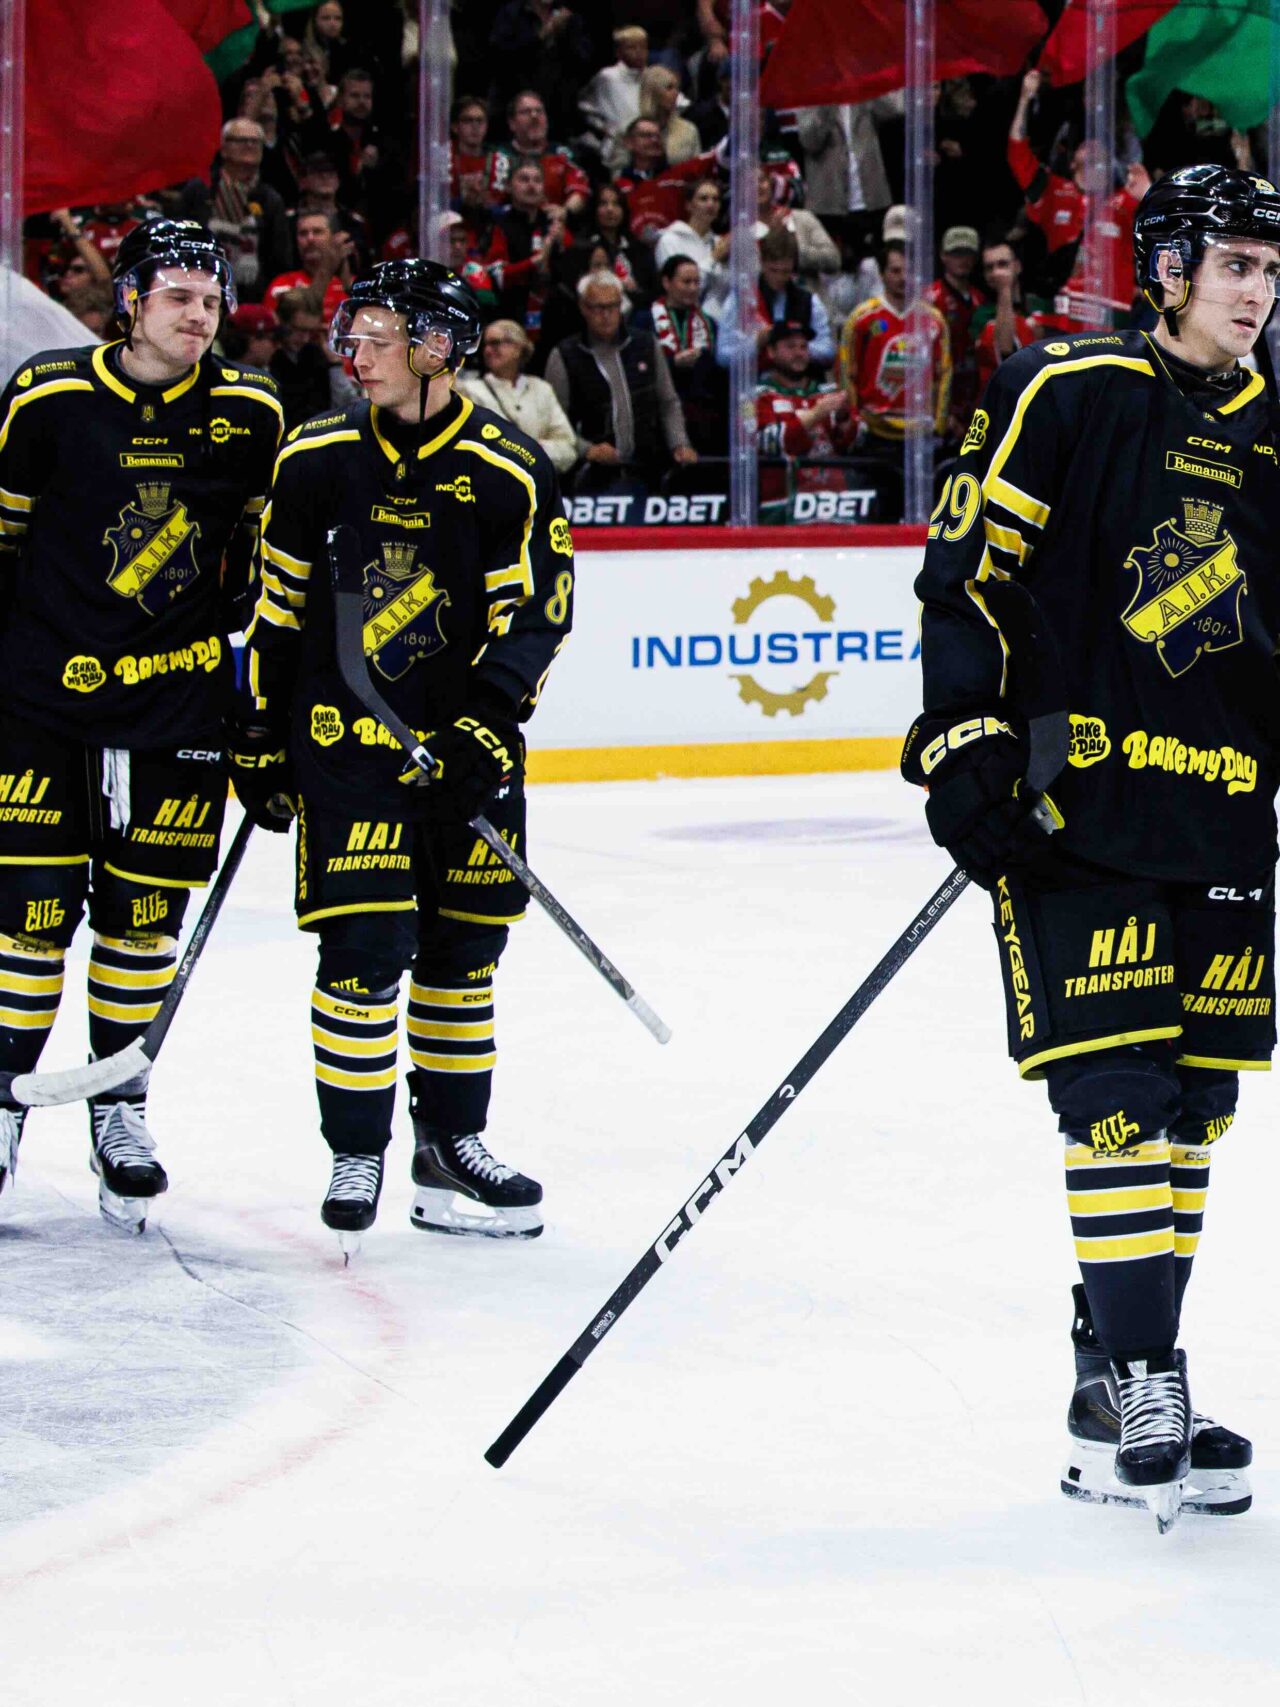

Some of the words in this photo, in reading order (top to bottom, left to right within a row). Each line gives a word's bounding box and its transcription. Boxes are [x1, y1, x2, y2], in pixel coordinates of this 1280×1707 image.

[1143, 214, 1166, 226] CCM
[180, 240, 214, 250] CCM
[352, 280, 375, 290] CCM
[448, 306, 470, 320] CCM
[132, 437, 168, 445] CCM
[1186, 436, 1232, 454] CCM
[126, 455, 178, 466] Bemannia
[1174, 456, 1237, 485] Bemannia
[644, 495, 726, 523] DBET
[794, 490, 876, 519] DBET
[545, 570, 573, 625] 8
[1197, 617, 1229, 635] 1891
[454, 716, 514, 773] CCM
[920, 716, 1018, 775] CCM
[176, 749, 221, 763] CCM
[0, 769, 51, 804] HÅJ
[0, 807, 62, 825] SPORTER
[153, 794, 211, 828] HÅJ
[131, 827, 216, 848] TRANSPORTER
[326, 854, 411, 873] TRANSPORTER
[446, 868, 515, 885] TRANSPOR
[905, 868, 968, 943] UNLEASHE
[123, 941, 158, 951] CCM
[1088, 916, 1157, 968] HÅJ
[998, 875, 1035, 1041] KEYGEAR
[1200, 946, 1265, 991] HÅJ
[1064, 964, 1175, 998] TRANSPORTER
[462, 994, 491, 1003] CCM
[334, 1006, 370, 1019] CCM
[1092, 1149, 1140, 1160] CCM
[655, 1131, 757, 1263] CCM
